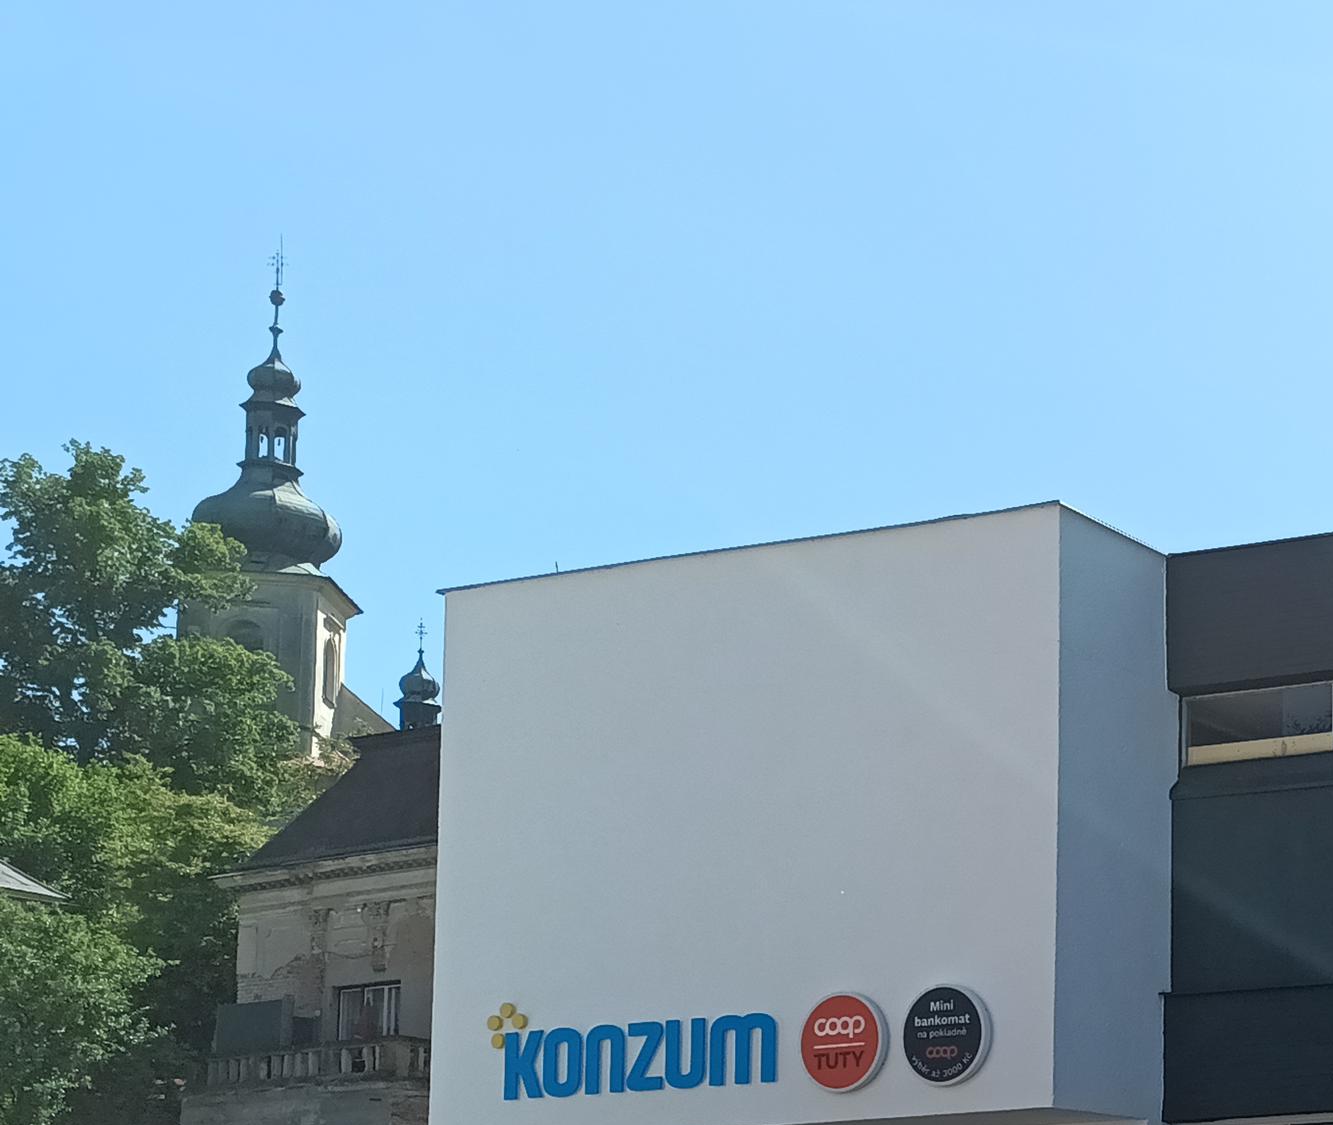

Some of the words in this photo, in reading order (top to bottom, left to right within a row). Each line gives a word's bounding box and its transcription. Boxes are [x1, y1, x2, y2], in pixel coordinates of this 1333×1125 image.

[930, 1000, 954, 1012] Mini
[814, 1015, 865, 1038] coop
[914, 1014, 970, 1027] bankomat
[917, 1030, 928, 1038] na
[929, 1027, 967, 1039] pokladně
[503, 1012, 777, 1100] KONZUM
[926, 1045, 958, 1059] coop
[814, 1051, 864, 1070] TUTY
